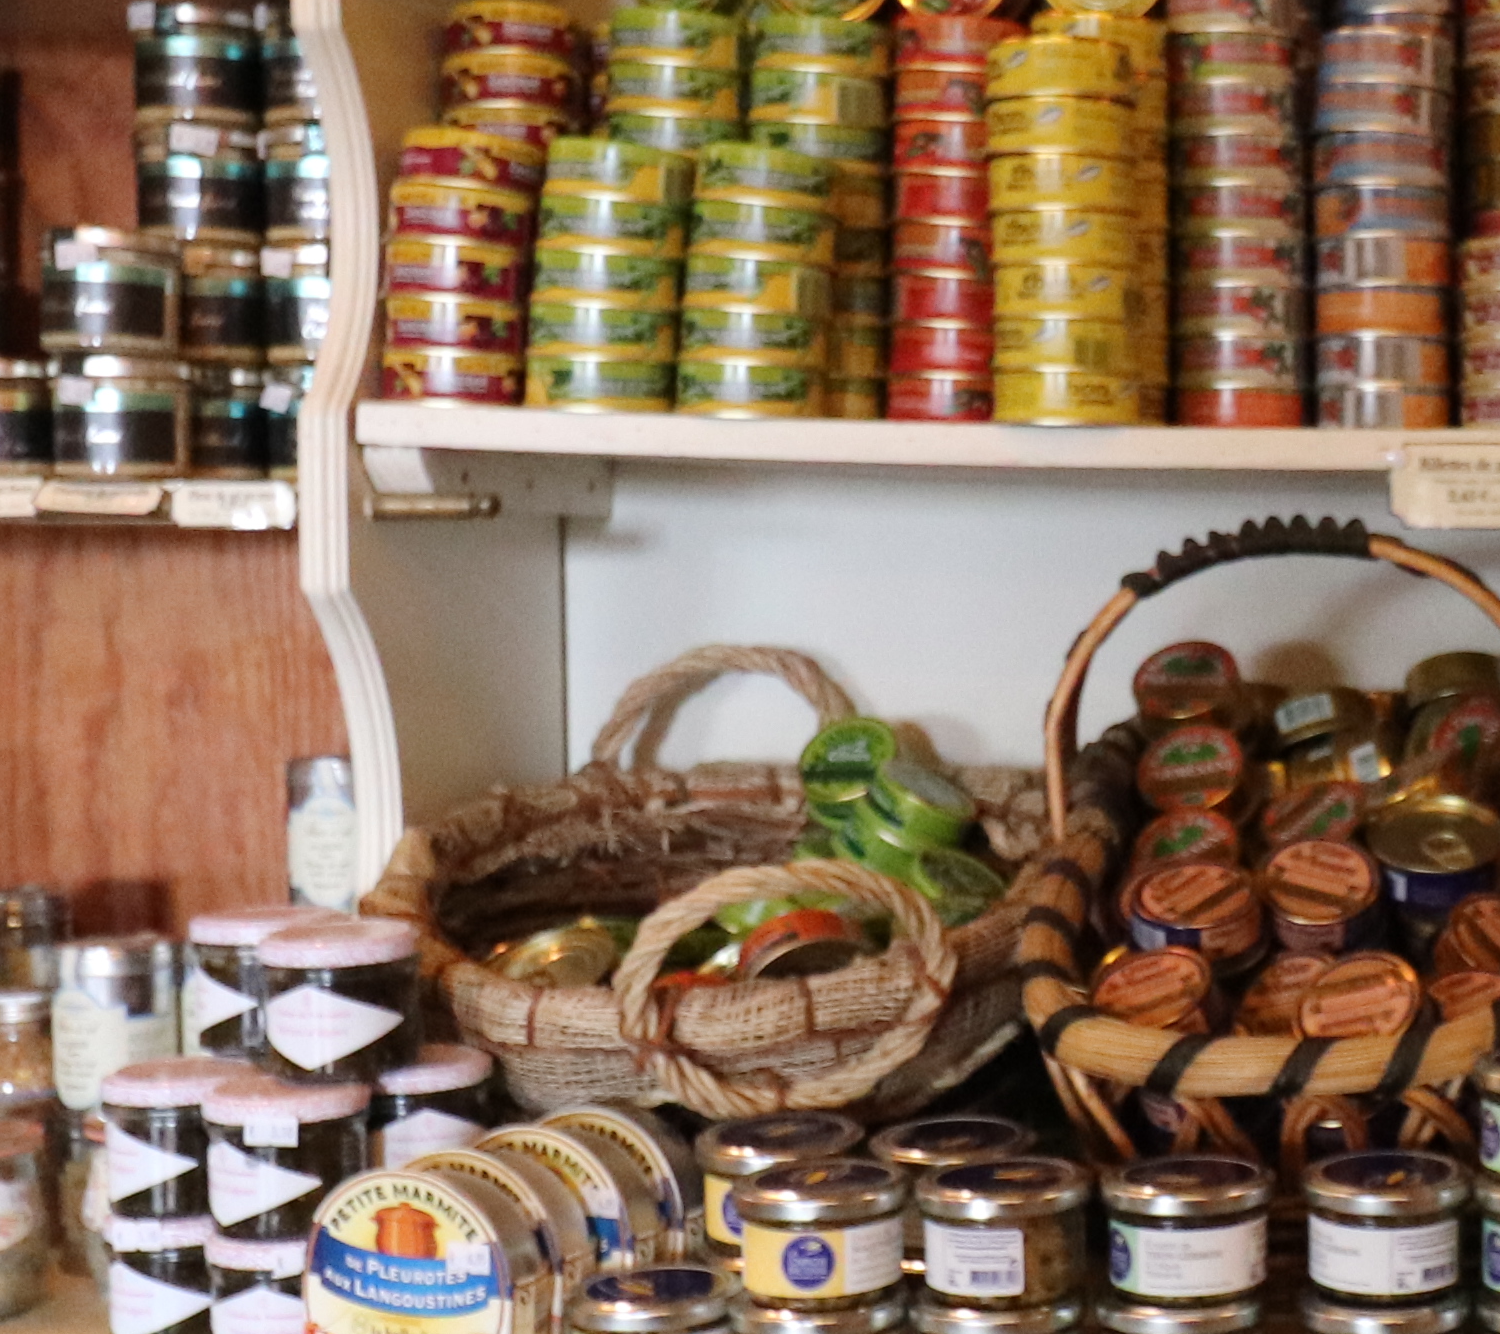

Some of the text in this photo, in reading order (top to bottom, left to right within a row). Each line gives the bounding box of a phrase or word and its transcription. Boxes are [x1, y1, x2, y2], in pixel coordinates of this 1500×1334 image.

[330, 1185, 387, 1232] PETITE
[392, 1183, 479, 1241] MARMITE
[323, 1266, 487, 1310] AUX LANGOUSTINES
[345, 1252, 363, 1274] DE
[366, 1257, 468, 1286] PLEUROTES
